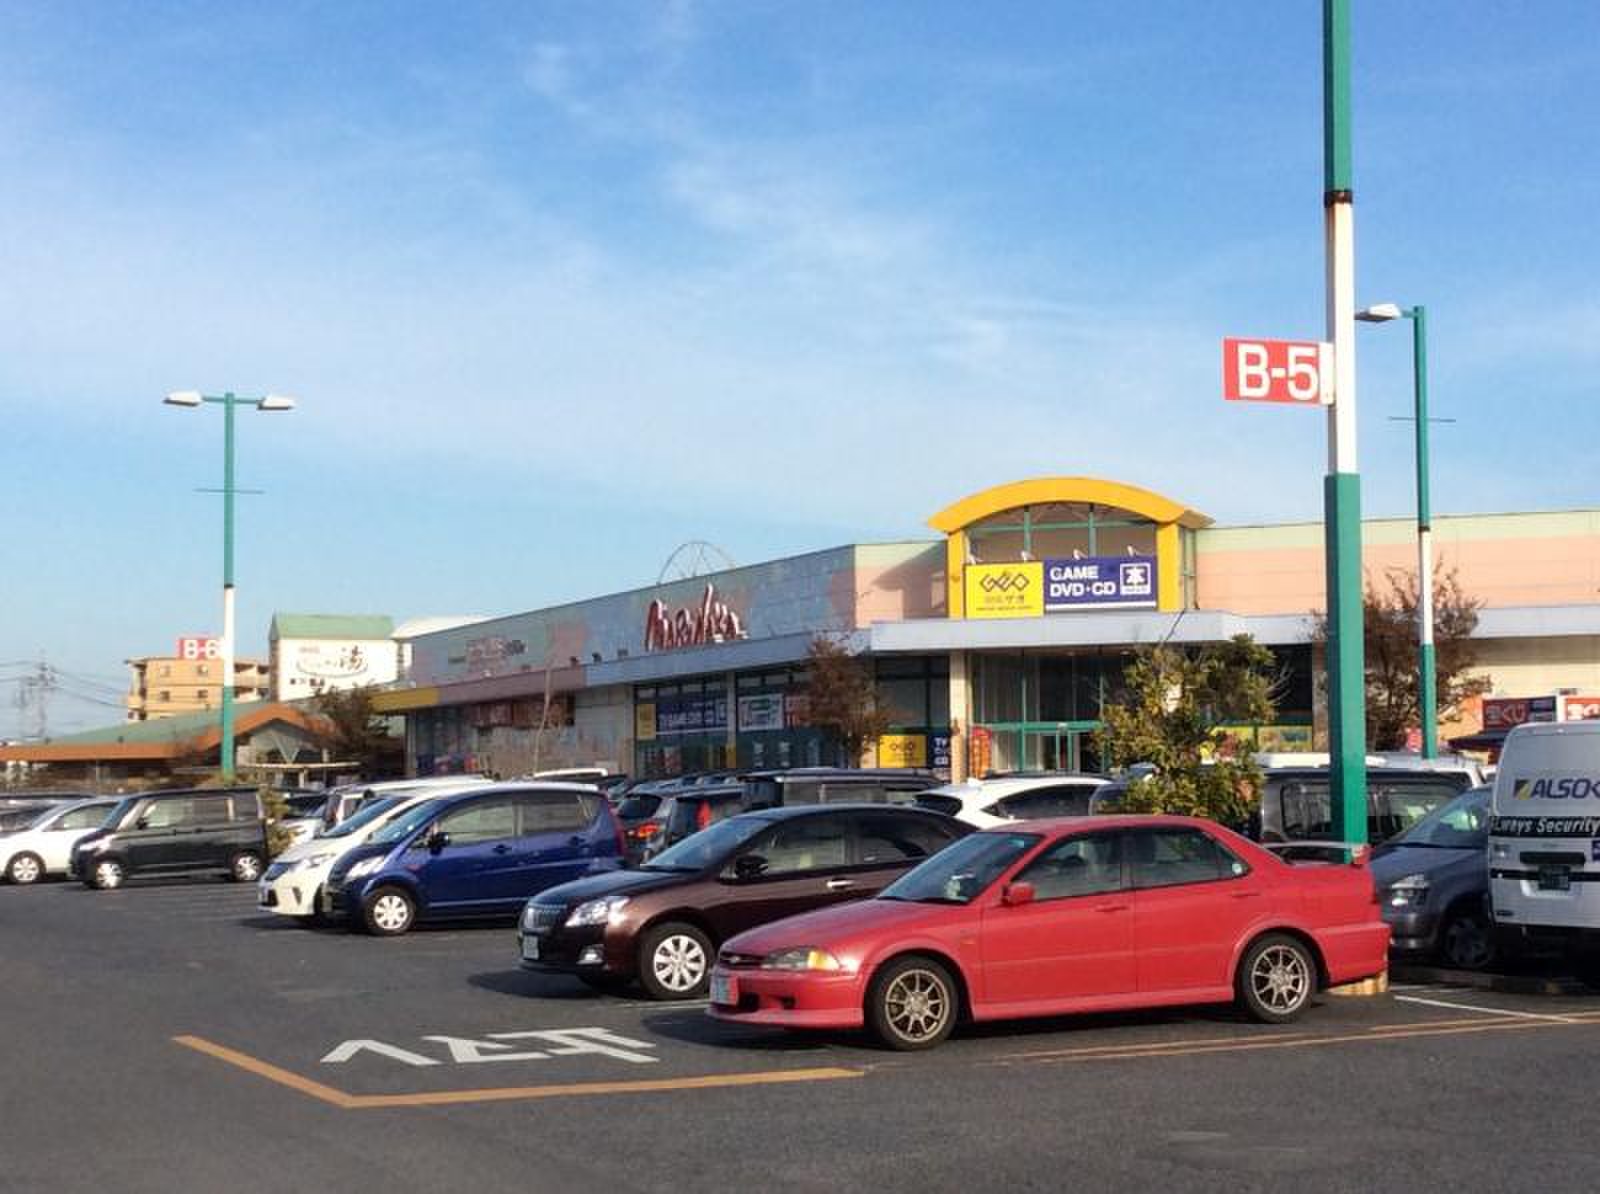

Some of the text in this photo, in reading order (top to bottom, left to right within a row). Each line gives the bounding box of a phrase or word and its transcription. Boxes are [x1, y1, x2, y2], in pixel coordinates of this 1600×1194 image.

[1238, 344, 1319, 401] B-5
[980, 572, 1030, 592] GEO
[1050, 566, 1099, 581] GAME
[1536, 817, 1600, 837] Security
